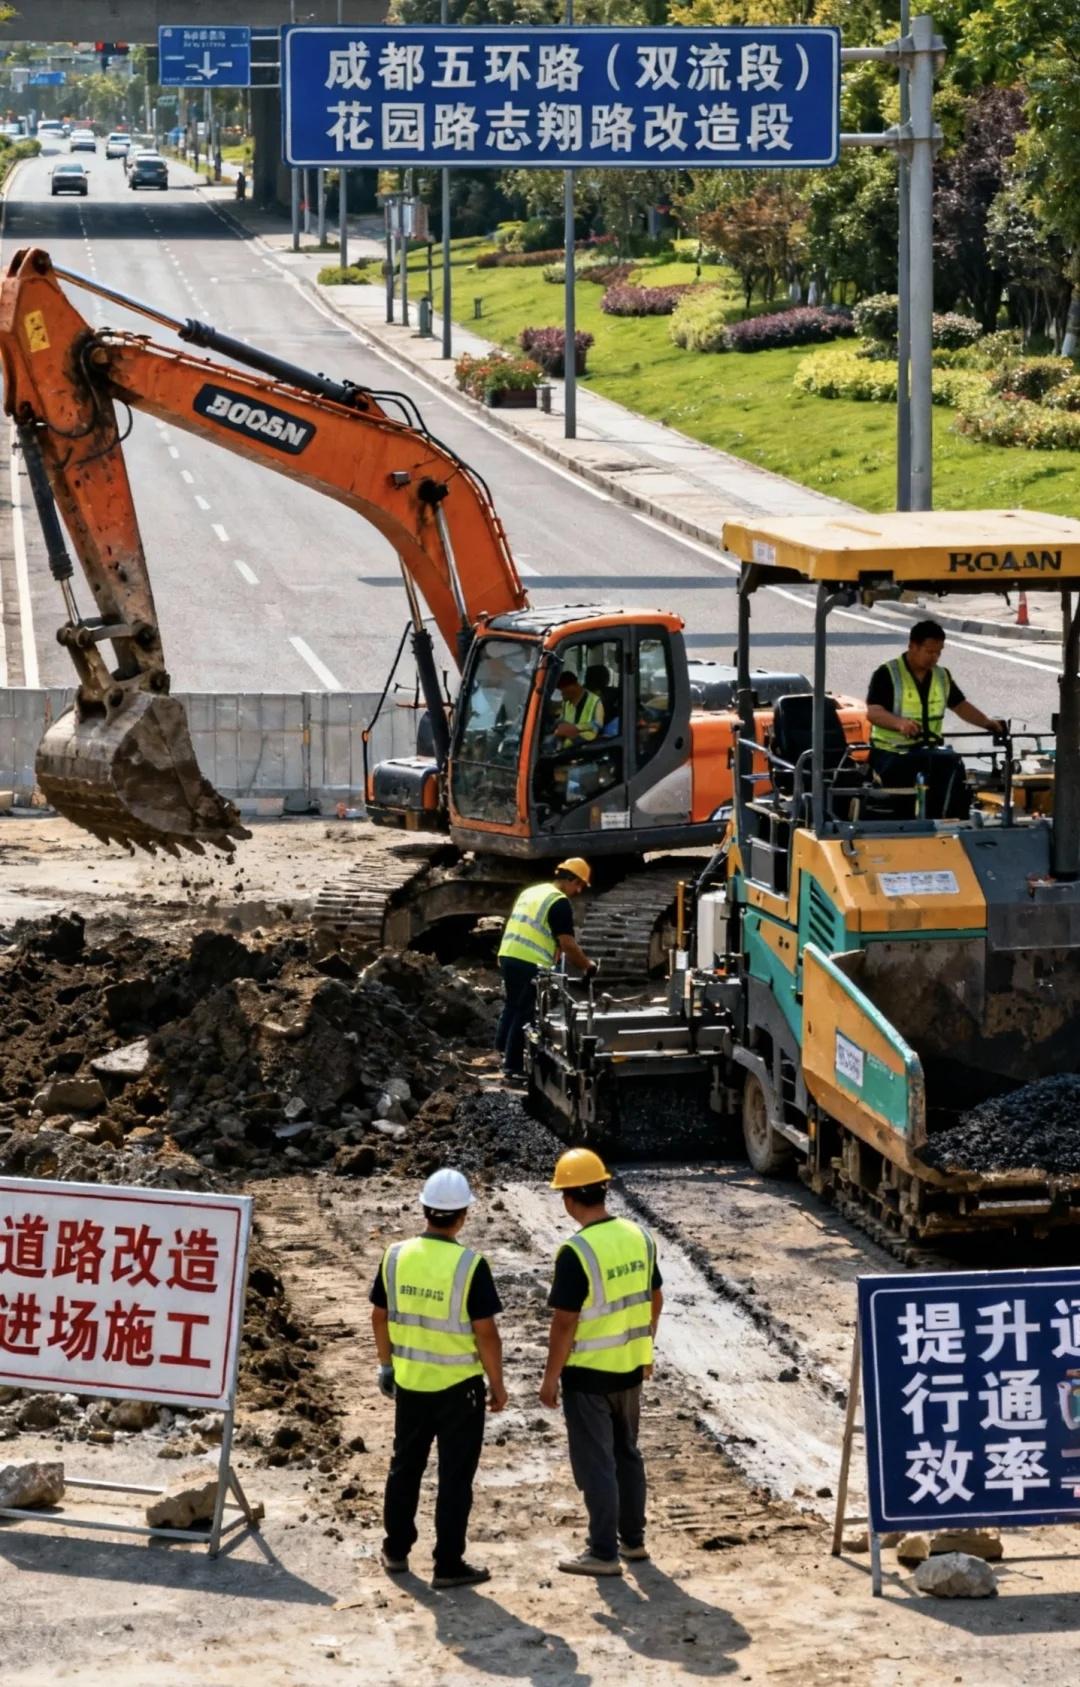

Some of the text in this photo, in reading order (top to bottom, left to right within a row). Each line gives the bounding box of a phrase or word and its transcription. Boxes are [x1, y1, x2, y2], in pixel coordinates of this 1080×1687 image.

[325, 41, 809, 92] 成都五环路（双流段）
[326, 101, 794, 152] 花园路志翔路改造段
[0, 1213, 219, 1293] 道路改造
[0, 1292, 211, 1368] 进场施工
